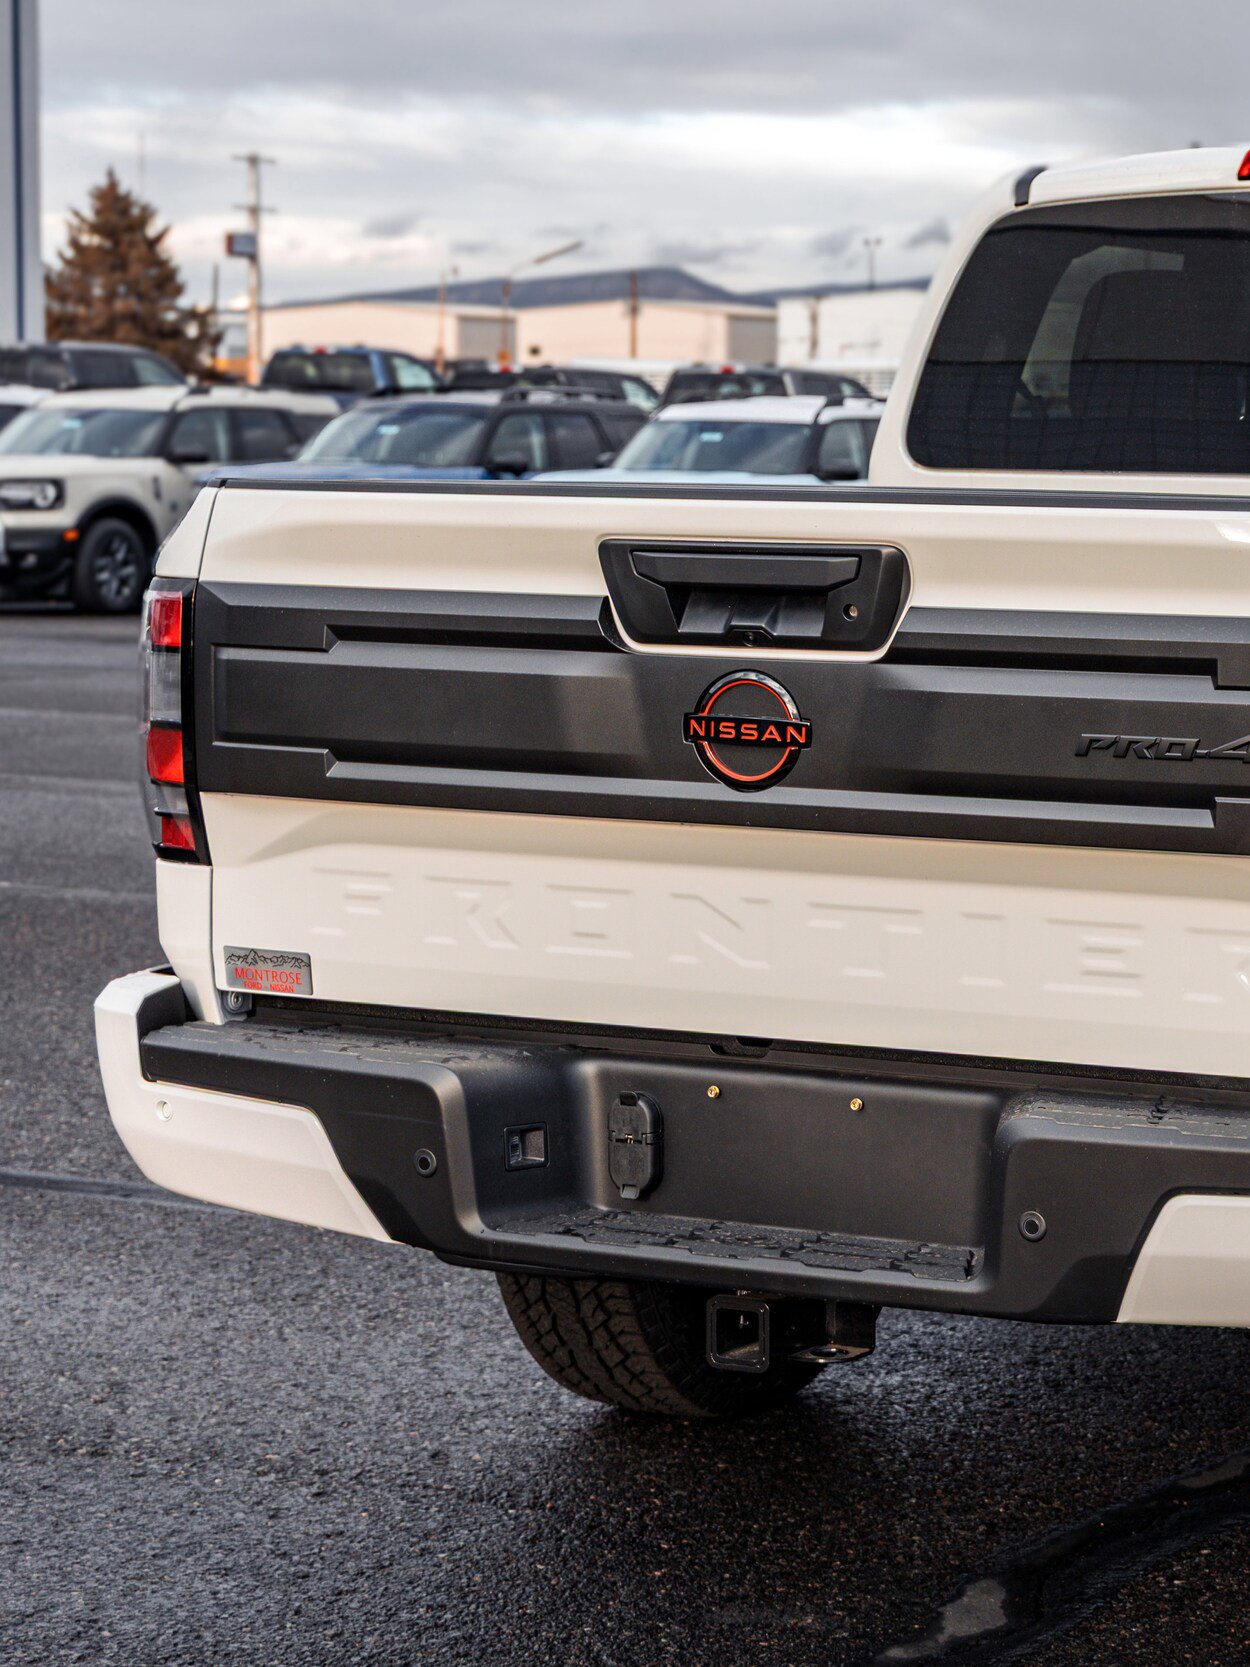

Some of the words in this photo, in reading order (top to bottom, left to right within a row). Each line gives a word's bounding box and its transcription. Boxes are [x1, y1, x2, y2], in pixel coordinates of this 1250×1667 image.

[689, 718, 806, 744] NISSAN
[234, 967, 302, 985] MONTROSE
[243, 980, 263, 990] FORD
[269, 983, 295, 993] NISSAN
